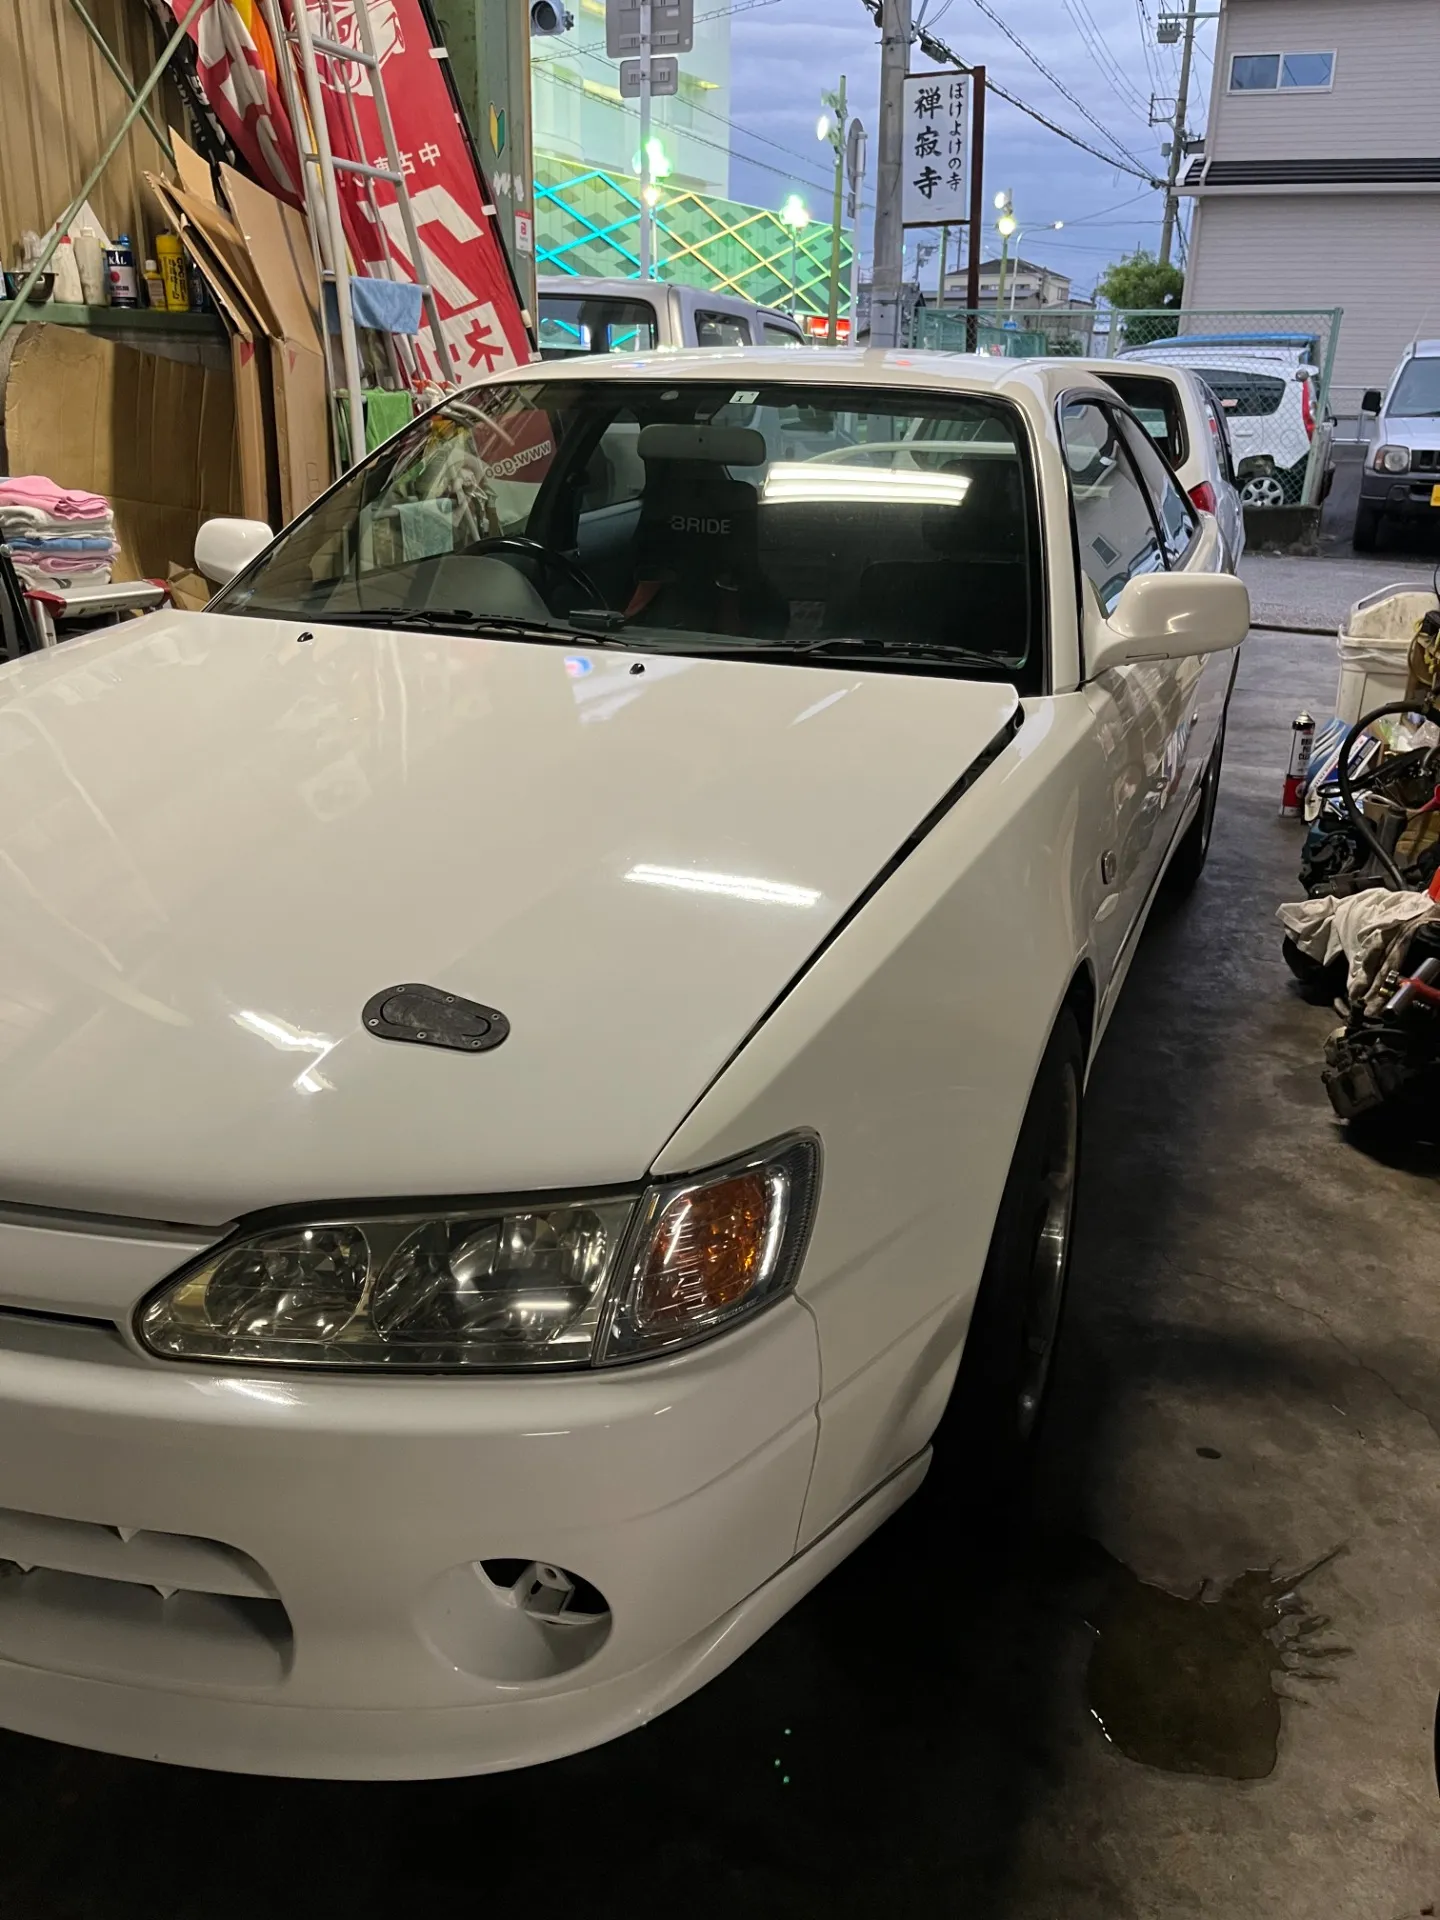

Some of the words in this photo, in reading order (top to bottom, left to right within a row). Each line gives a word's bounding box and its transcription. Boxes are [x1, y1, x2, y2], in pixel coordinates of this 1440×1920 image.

[912, 86, 944, 200] 禅寂寺
[946, 82, 966, 192] ぼけよけの寺
[668, 515, 731, 534] BRIDE
